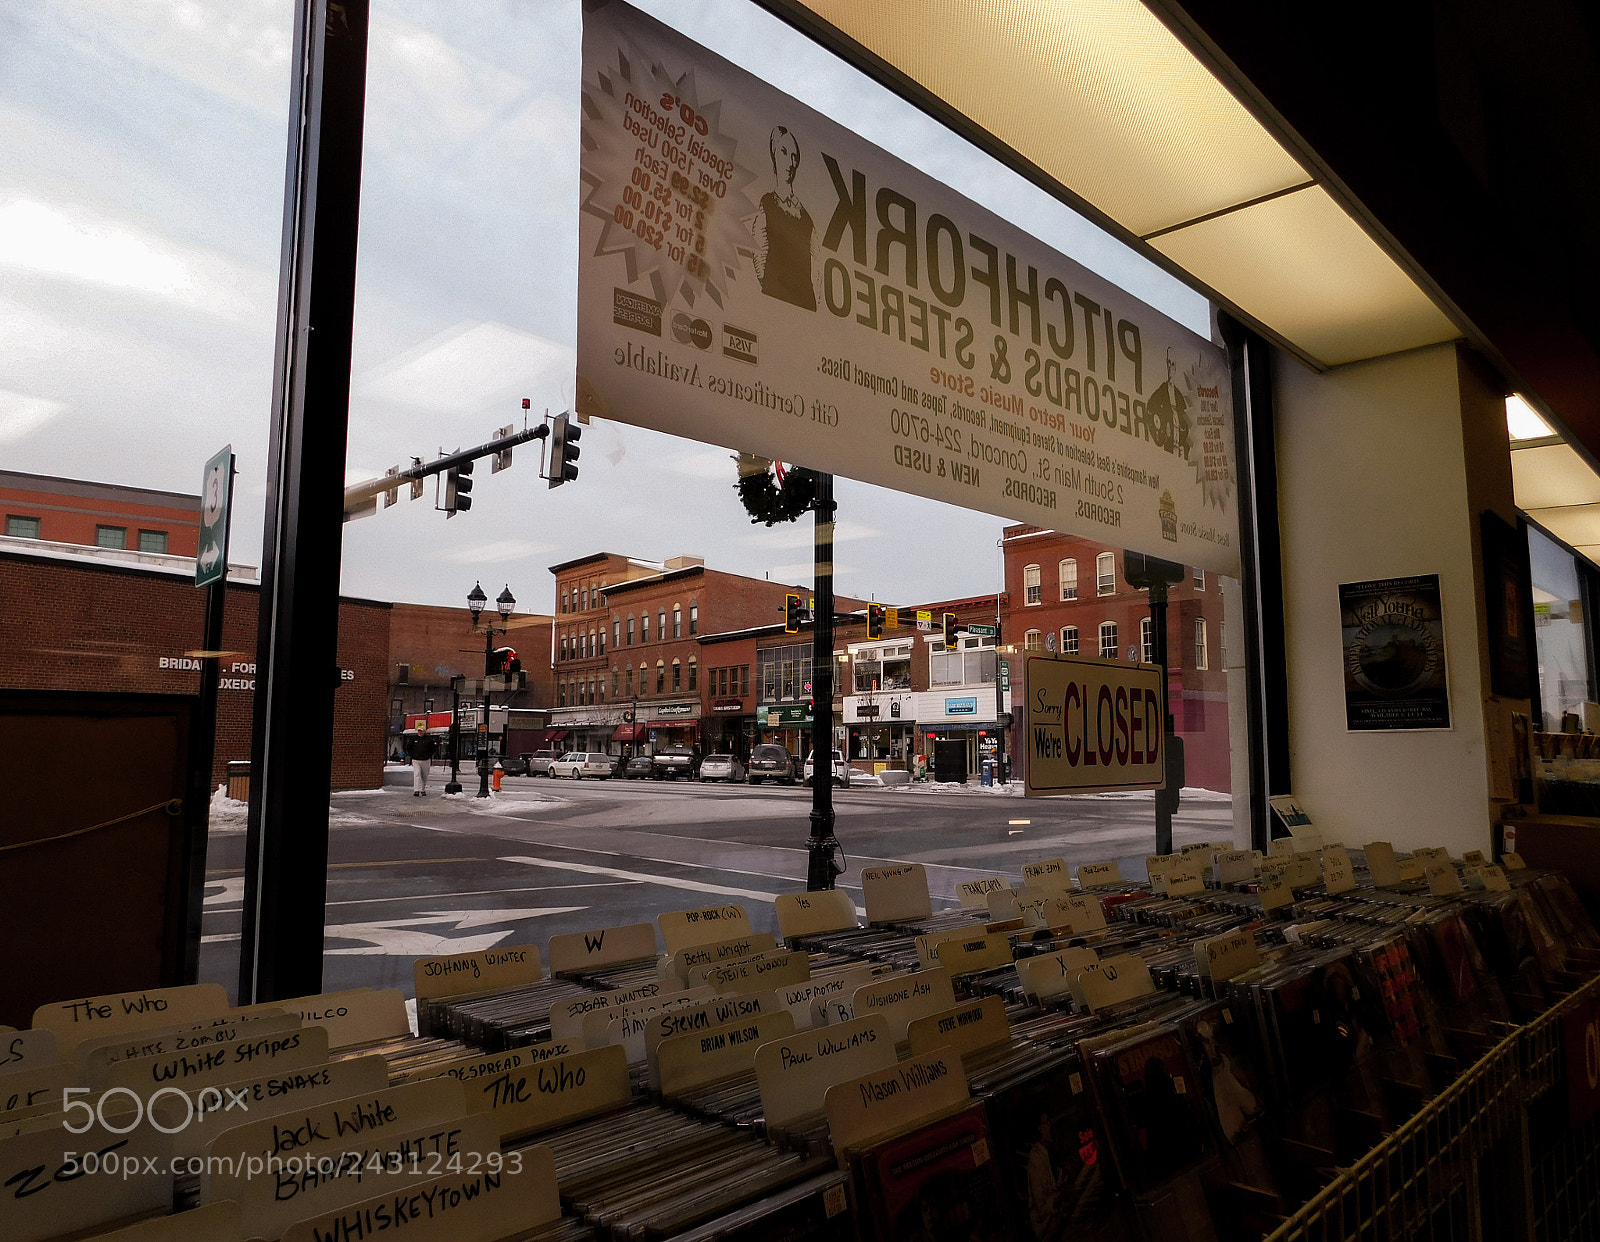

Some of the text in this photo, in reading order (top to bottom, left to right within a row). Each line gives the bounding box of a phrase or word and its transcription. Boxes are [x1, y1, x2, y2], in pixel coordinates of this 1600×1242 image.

[210, 479, 219, 514] 3
[1352, 596, 1424, 626] Neil Young
[1033, 688, 1062, 720] Sorry
[1064, 681, 1160, 768] CLOSED
[1034, 727, 1062, 759] We're
[865, 871, 880, 880] NEIL
[687, 910, 720, 923] POP-ROCK
[795, 896, 811, 909] Yes
[485, 951, 527, 966] WINTER
[584, 930, 606, 955] W
[684, 941, 751, 966] Betty Wright
[1056, 956, 1068, 976] X
[62, 990, 168, 1022] The Who
[567, 984, 660, 1018] EDGAR WINTER
[866, 982, 931, 1008] WISHBONE ASH
[660, 999, 761, 1038] Steven Wilson
[938, 1016, 956, 1034] STEVE
[700, 1025, 760, 1052] BRIAN WILSON
[780, 1029, 877, 1070] PAUL WILLIAMS
[153, 1050, 225, 1082] White
[418, 1044, 570, 1082] DESPREAD PANIC
[484, 1063, 587, 1109] The Who
[859, 1060, 948, 1109] Mason Williams
[263, 1099, 397, 1158] Jack White
[273, 1149, 369, 1202] BARRY
[313, 1172, 501, 1242] WHISKEYTOWN
